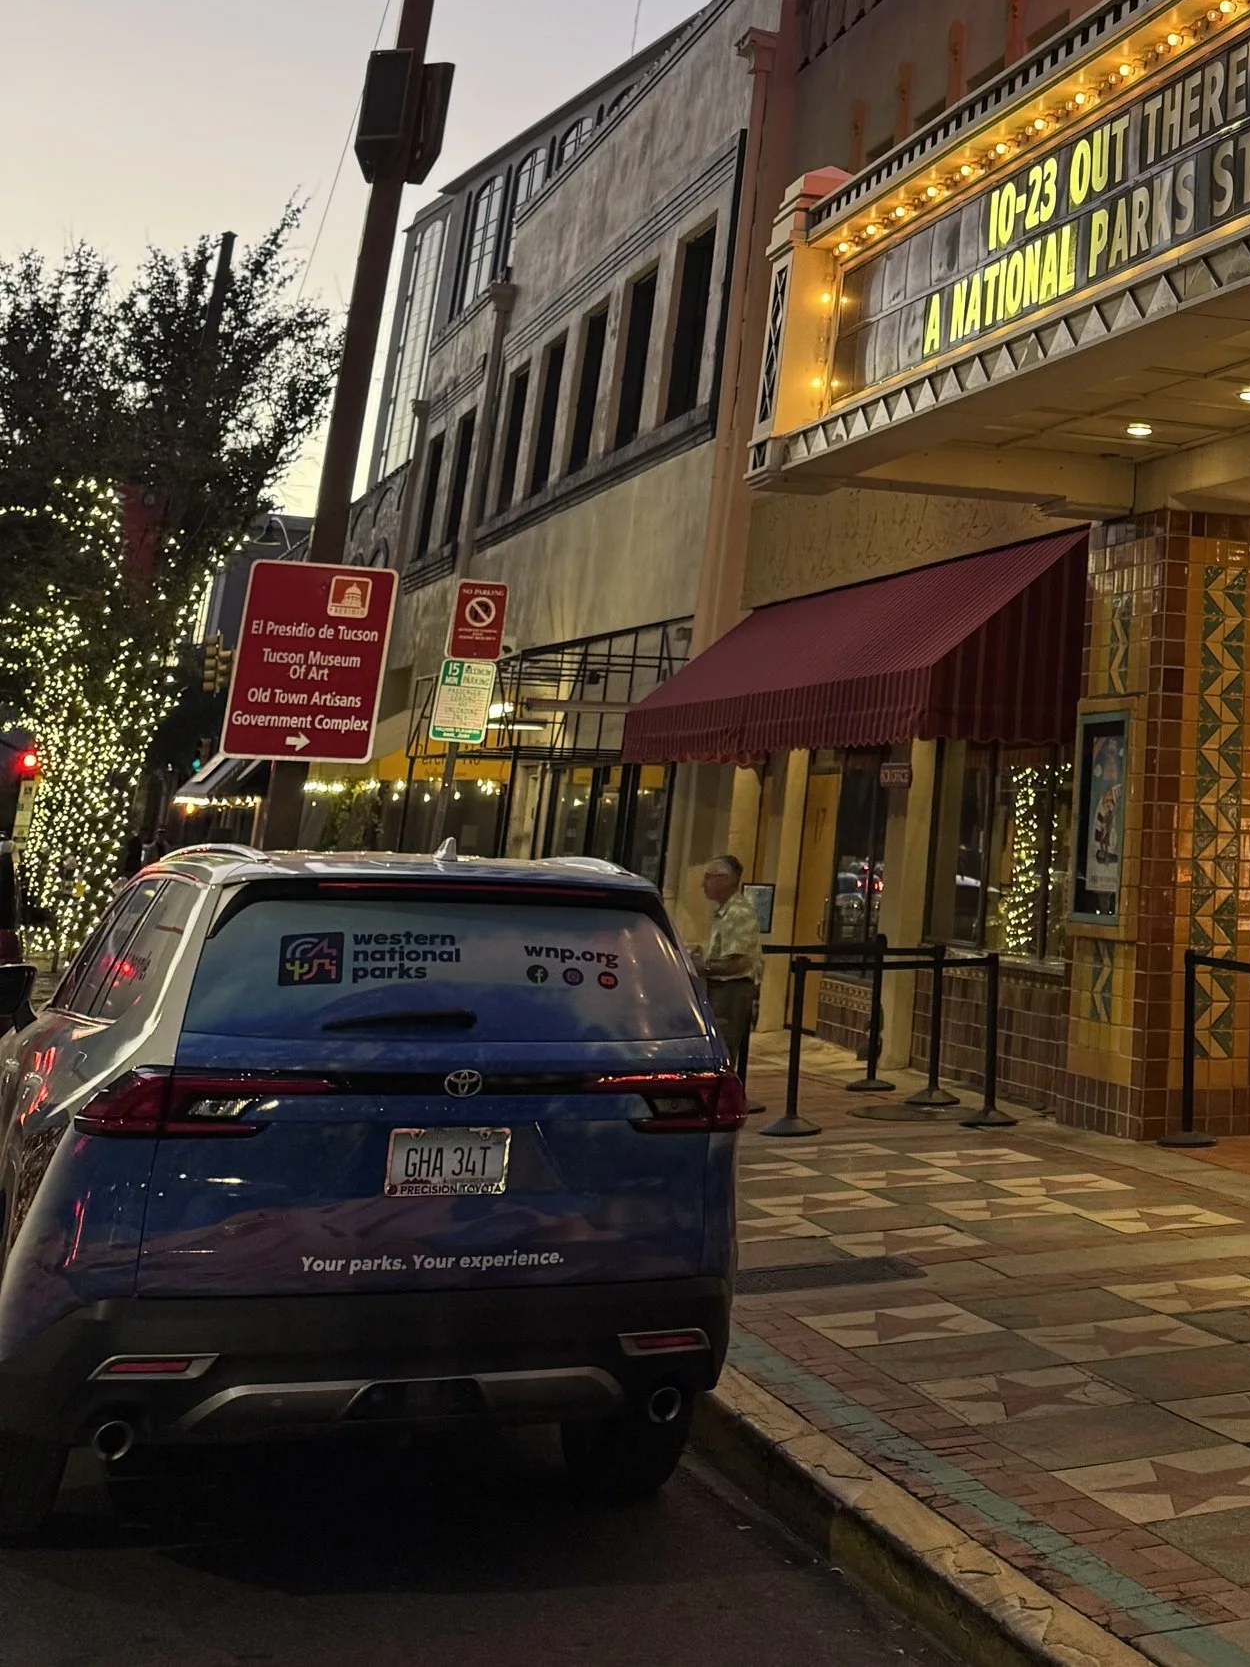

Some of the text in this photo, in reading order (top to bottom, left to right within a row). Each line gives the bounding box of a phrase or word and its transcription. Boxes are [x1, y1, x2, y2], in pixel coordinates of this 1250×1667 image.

[988, 45, 1249, 252] 10-23 OUT THERE
[923, 293, 941, 356] A
[949, 224, 1076, 343] NATIONAL
[1088, 160, 1195, 278] PARKS
[474, 589, 505, 597] PARKING
[251, 620, 379, 642] El Presidio de Tucson
[262, 648, 361, 667] Tucson Museum
[289, 665, 329, 681] Of Art
[247, 687, 362, 708] Old Town Artisans
[231, 710, 369, 734] Government Complex
[352, 931, 456, 946] western
[352, 947, 461, 962] national
[524, 945, 618, 969] wnp.org
[352, 963, 427, 983] parks
[404, 1146, 492, 1178] GHA 34T
[400, 1183, 503, 1195] PRECISION TOYOTA
[301, 1250, 565, 1275] Your parks. Your experience.
